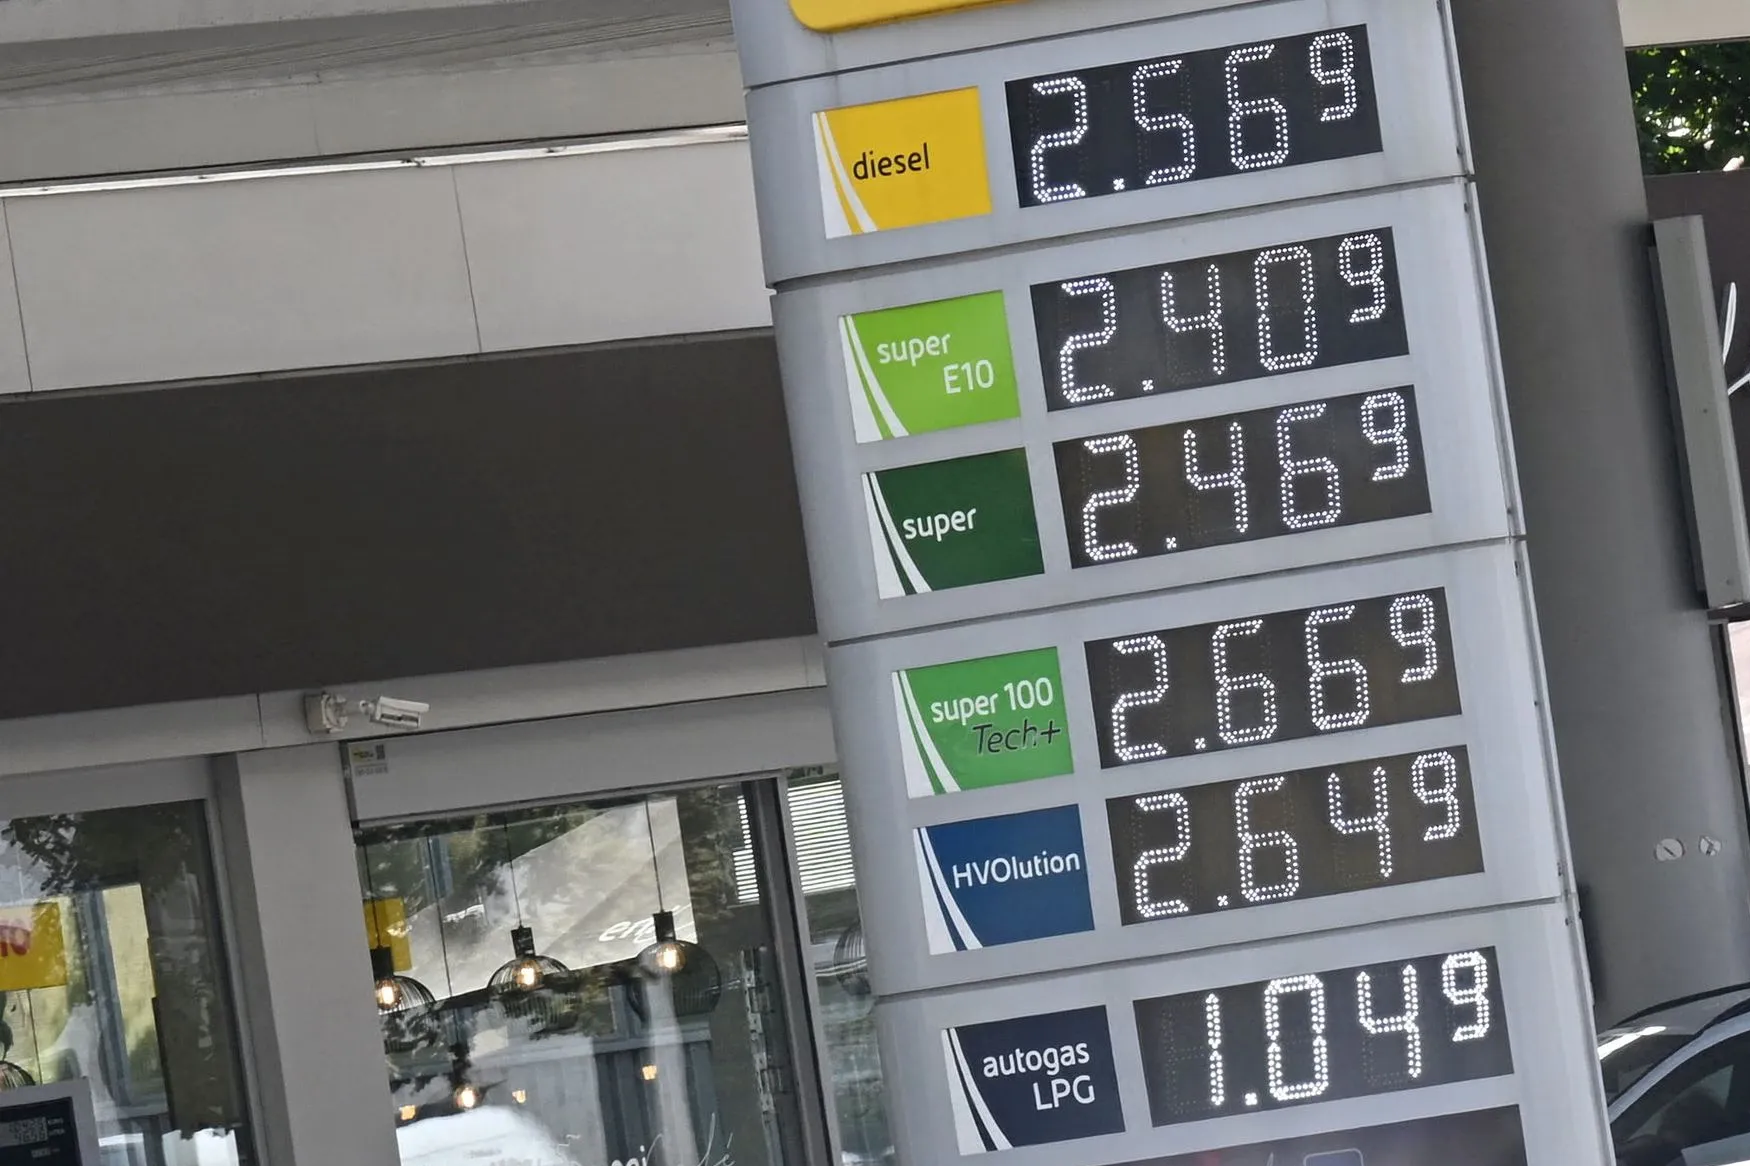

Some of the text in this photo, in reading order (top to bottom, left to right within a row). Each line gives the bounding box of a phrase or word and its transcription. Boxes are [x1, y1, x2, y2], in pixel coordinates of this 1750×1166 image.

[1030, 31, 1357, 203] 2.569
[852, 143, 931, 181] diesel
[1059, 233, 1386, 404] 2.409
[878, 332, 951, 368] super
[943, 359, 995, 394] E10
[1081, 391, 1410, 562] 2.469
[903, 505, 978, 543] super
[1111, 597, 1438, 763] 2.669
[931, 676, 1054, 726] super 100
[973, 718, 1062, 757] Tech+
[1133, 750, 1460, 918] 2.649
[952, 849, 1081, 890] HVOlution
[1207, 951, 1489, 1107] 1.049
[982, 1040, 1090, 1081] autogas
[1033, 1077, 1095, 1111] LPG
